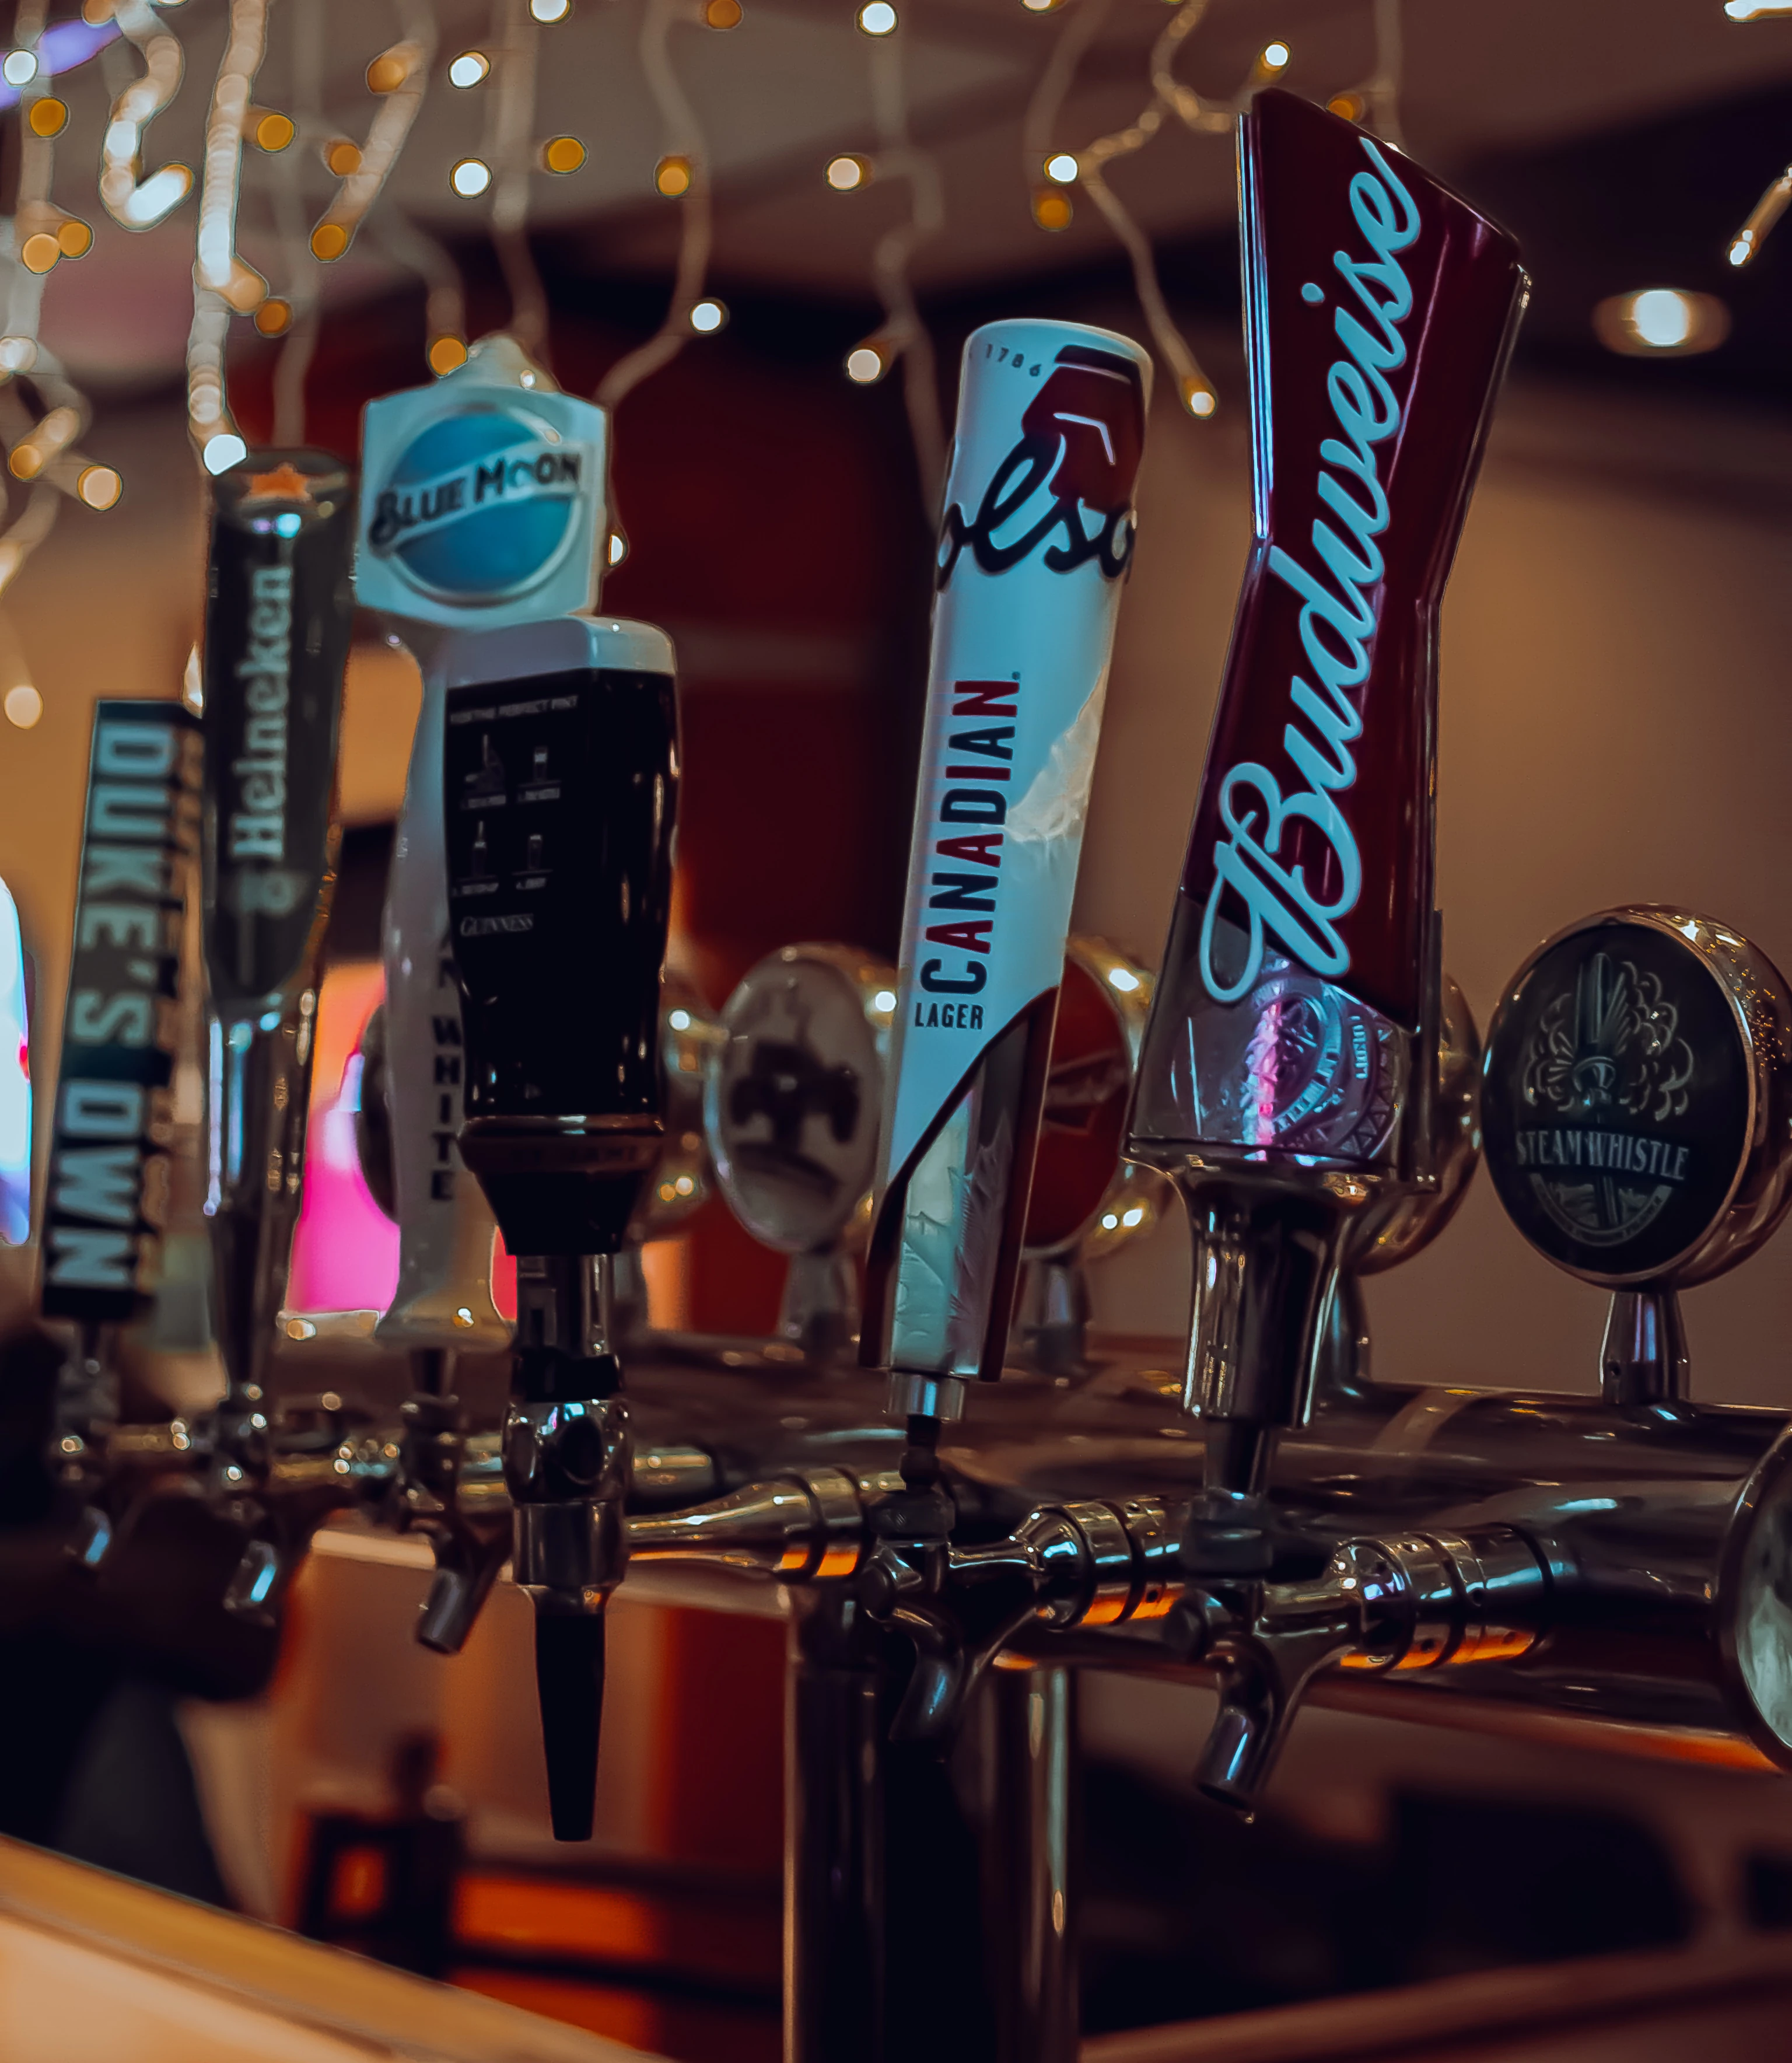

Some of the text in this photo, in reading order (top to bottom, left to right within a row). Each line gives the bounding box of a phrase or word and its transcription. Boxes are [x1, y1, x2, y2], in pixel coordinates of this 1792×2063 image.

[986, 344, 1042, 377] 1786
[368, 477, 465, 558] BLUE
[936, 432, 1135, 591] olso
[1200, 136, 1421, 1002] Budweise
[231, 565, 292, 858] Heineken
[920, 680, 1020, 995] CANADIAN
[50, 720, 176, 1287] DUKE'S OWN
[915, 1002, 984, 1030] LAGER
[432, 1016, 464, 1201] WHITE
